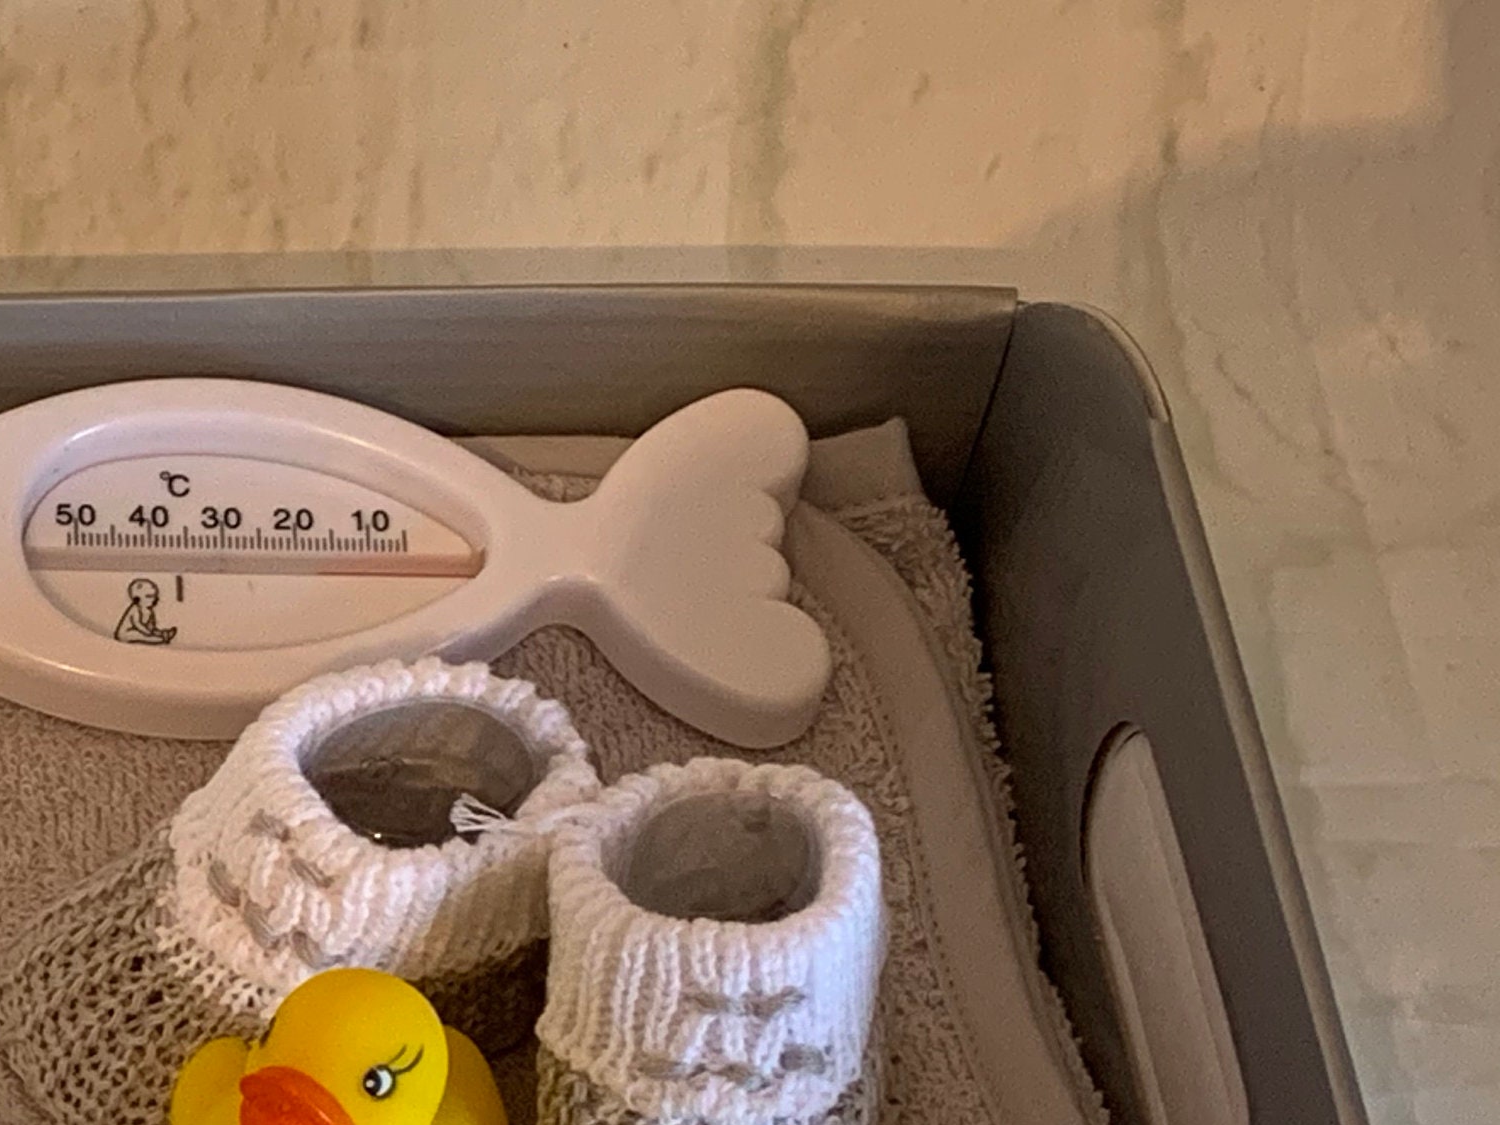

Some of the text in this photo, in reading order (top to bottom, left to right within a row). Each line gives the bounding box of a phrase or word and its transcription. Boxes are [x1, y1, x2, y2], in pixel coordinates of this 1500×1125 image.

[55, 504, 390, 532] 50 40 30 20 10
